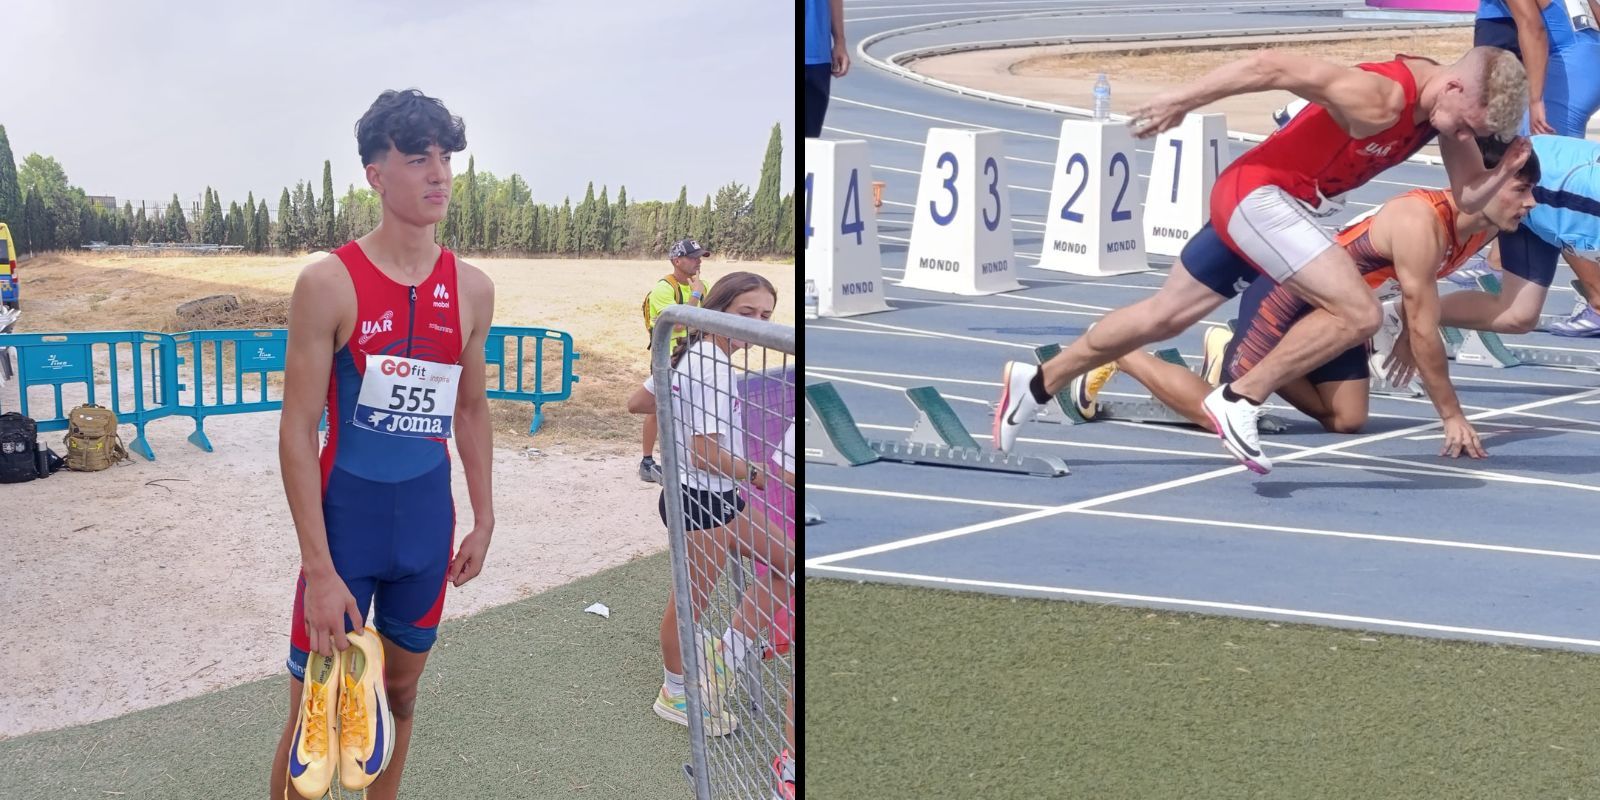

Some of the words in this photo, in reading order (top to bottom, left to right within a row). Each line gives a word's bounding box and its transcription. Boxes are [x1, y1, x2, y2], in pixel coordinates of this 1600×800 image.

[1364, 141, 1392, 156] UAR
[1169, 139, 1183, 203] 1
[930, 151, 959, 226] 3
[982, 156, 1001, 232] 3
[1060, 152, 1089, 223] 2
[1109, 152, 1132, 222] 2
[841, 168, 865, 246] 4
[1152, 226, 1189, 240] MONDO
[1053, 240, 1087, 255] MONDO
[1106, 239, 1136, 253] MONDO
[919, 257, 960, 273] MONDO
[982, 260, 1008, 275] MONDO
[842, 281, 874, 296] MONDO
[361, 320, 393, 335] UAR
[388, 384, 436, 413] 555
[386, 414, 443, 434] Joma
